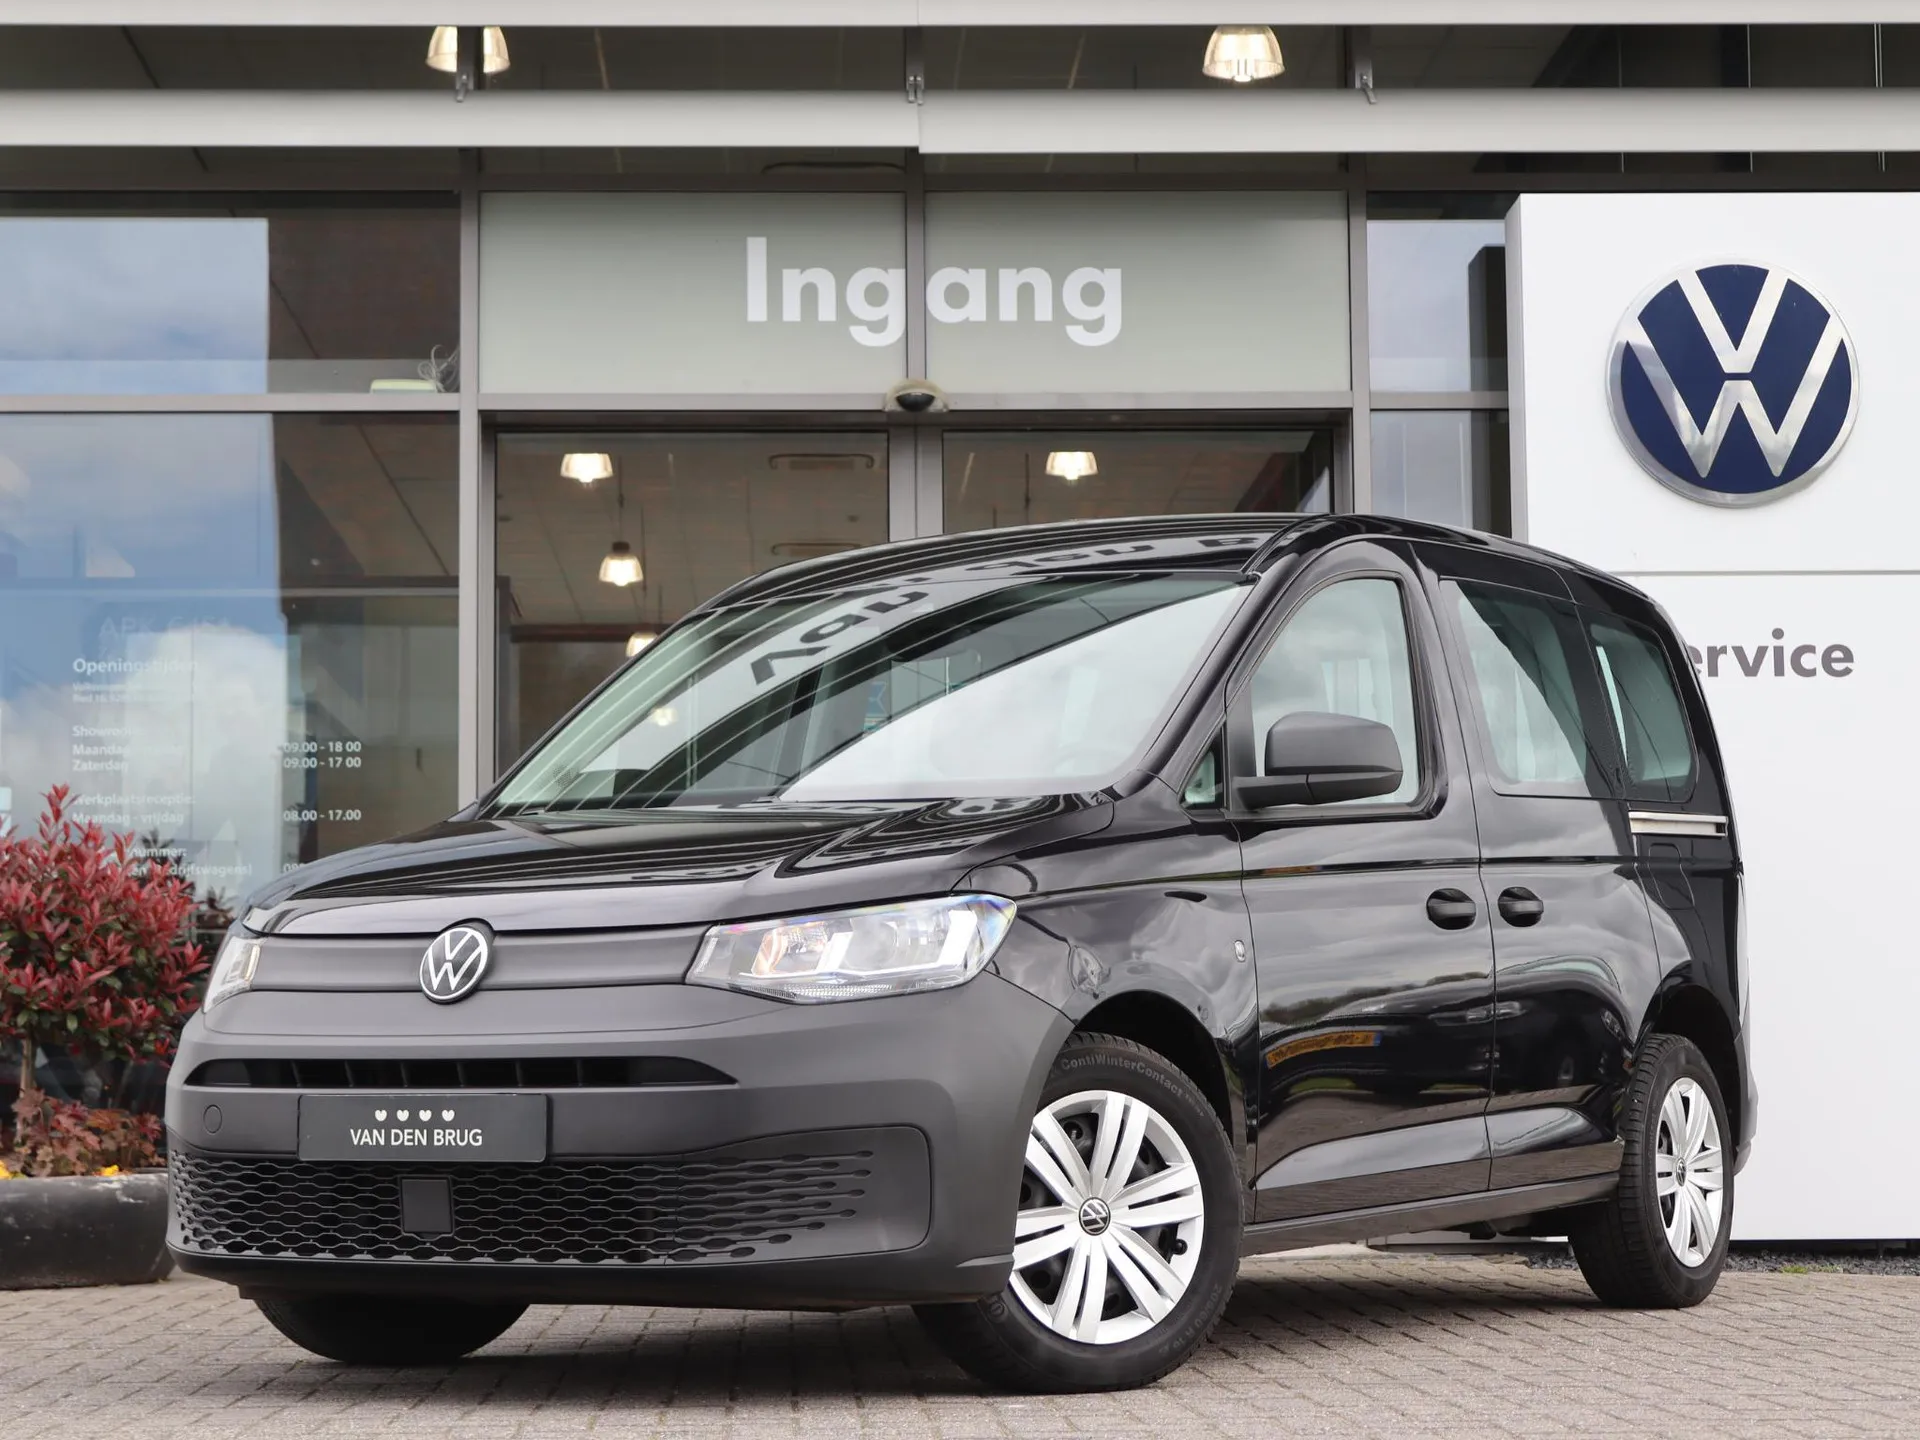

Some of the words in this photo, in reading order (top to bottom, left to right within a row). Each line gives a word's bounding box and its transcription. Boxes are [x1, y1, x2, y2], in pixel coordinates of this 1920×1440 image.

[747, 236, 1122, 347] Ingang
[1687, 627, 1854, 678] ervice
[72, 760, 129, 772] Zaterdag
[283, 809, 317, 821] 08.00
[328, 809, 362, 821] 17.00
[1061, 1053, 1183, 1099] ContiWinterContact
[350, 1128, 385, 1146] VAN
[390, 1128, 427, 1146] DEN
[433, 1128, 483, 1147] BRUG
